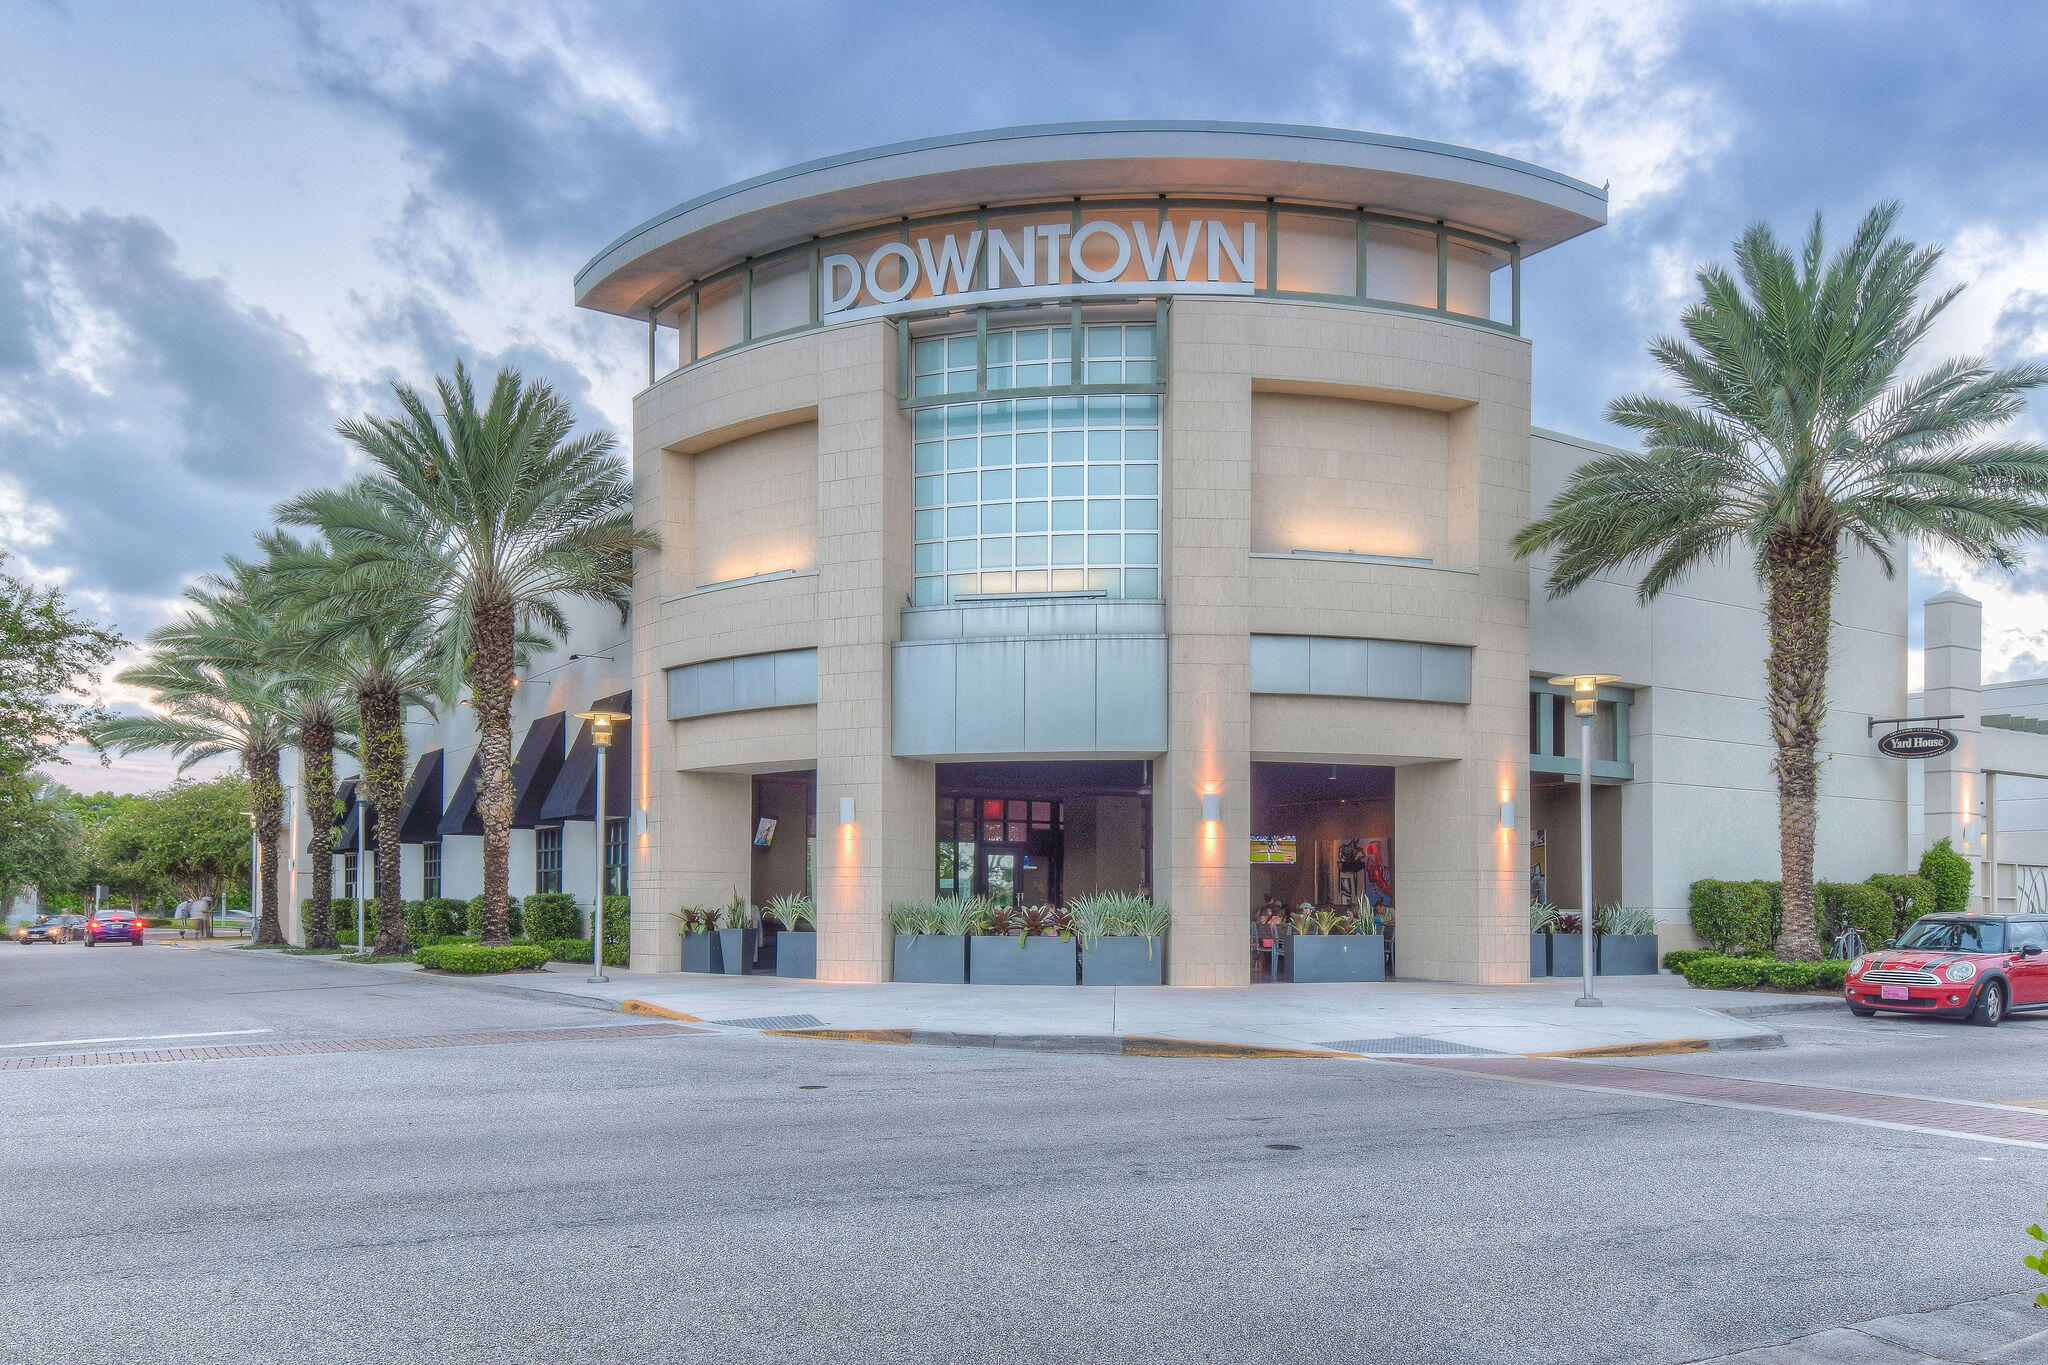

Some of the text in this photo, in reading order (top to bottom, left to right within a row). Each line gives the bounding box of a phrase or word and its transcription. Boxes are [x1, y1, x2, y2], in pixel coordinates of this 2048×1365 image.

[823, 219, 1255, 314] DOWNTOWN
[1890, 737, 1944, 749] Yard House
